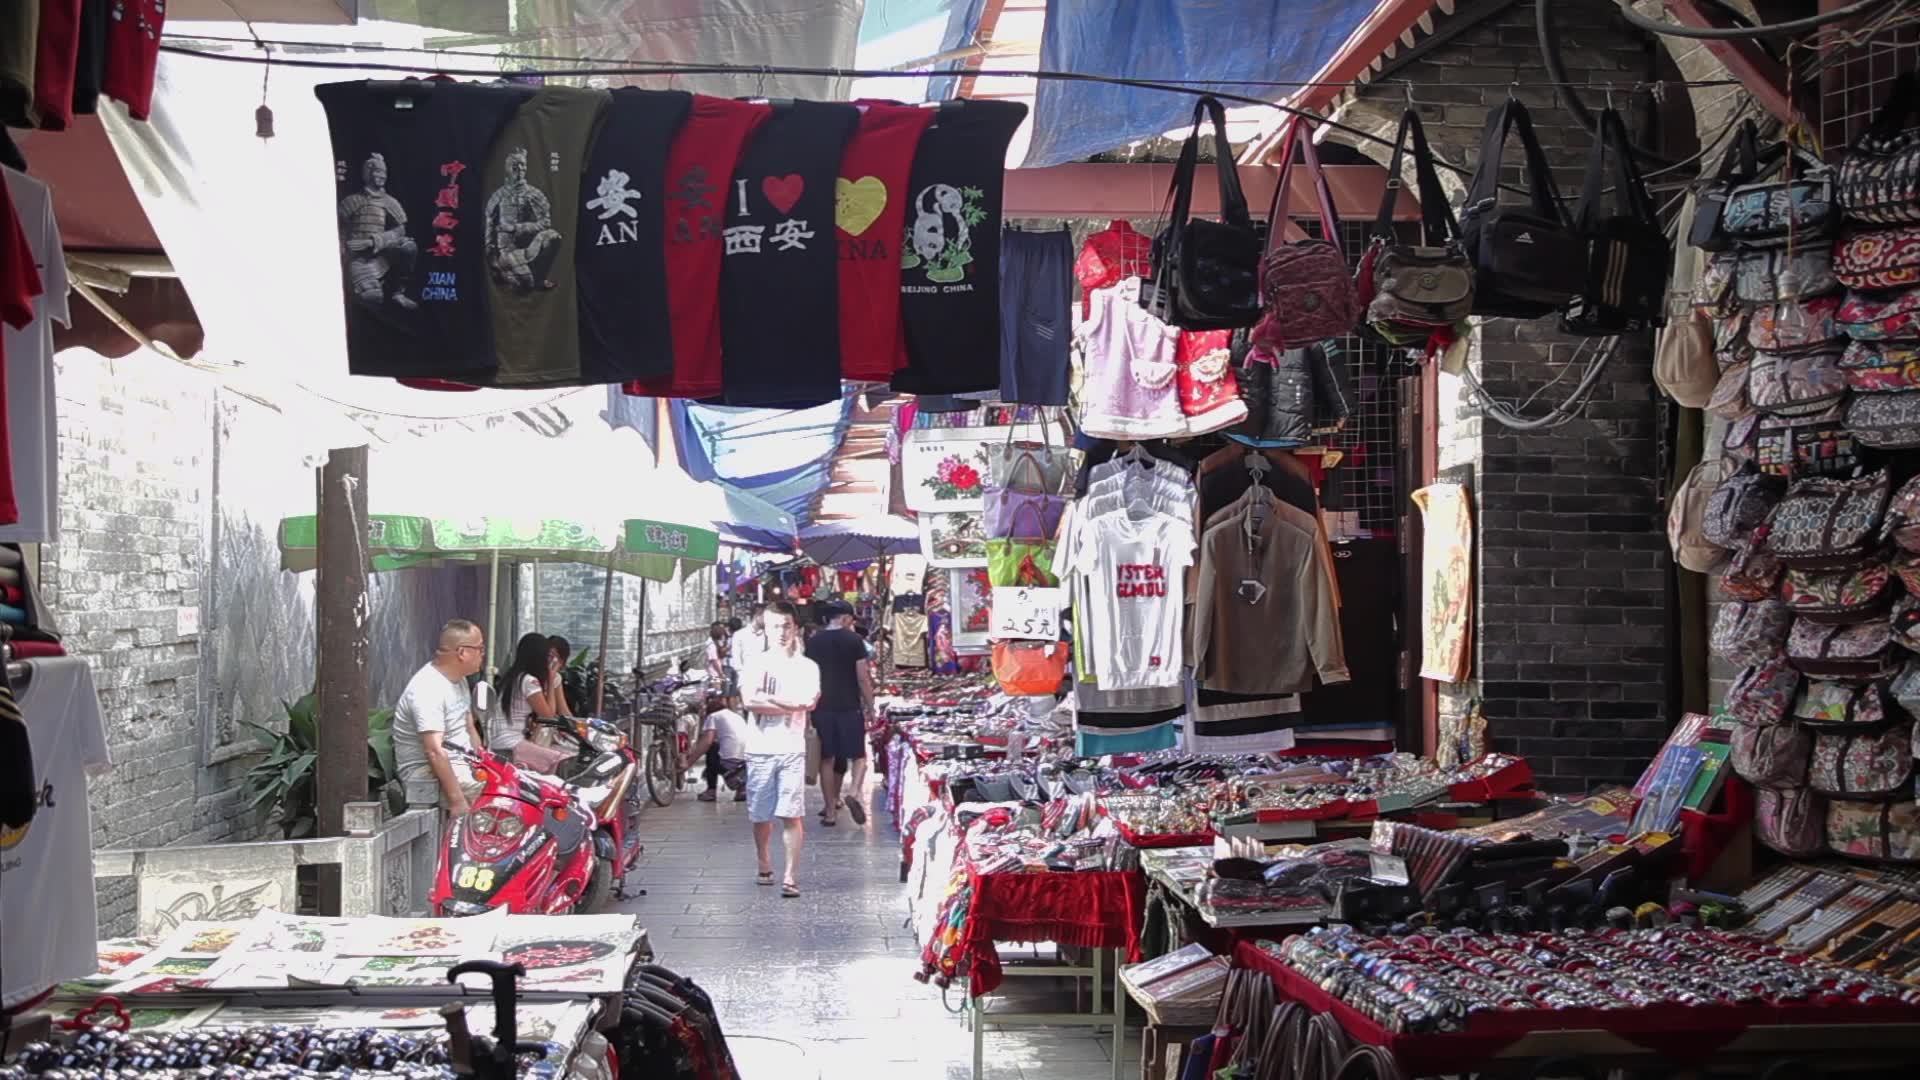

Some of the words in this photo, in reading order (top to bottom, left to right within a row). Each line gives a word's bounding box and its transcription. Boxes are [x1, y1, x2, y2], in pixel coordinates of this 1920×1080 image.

[735, 178, 751, 217] I
[595, 220, 639, 246] AN
[722, 218, 816, 256] 西安
[427, 271, 457, 286] XIAN
[942, 282, 974, 293] CHINA
[421, 287, 459, 301] CHINA
